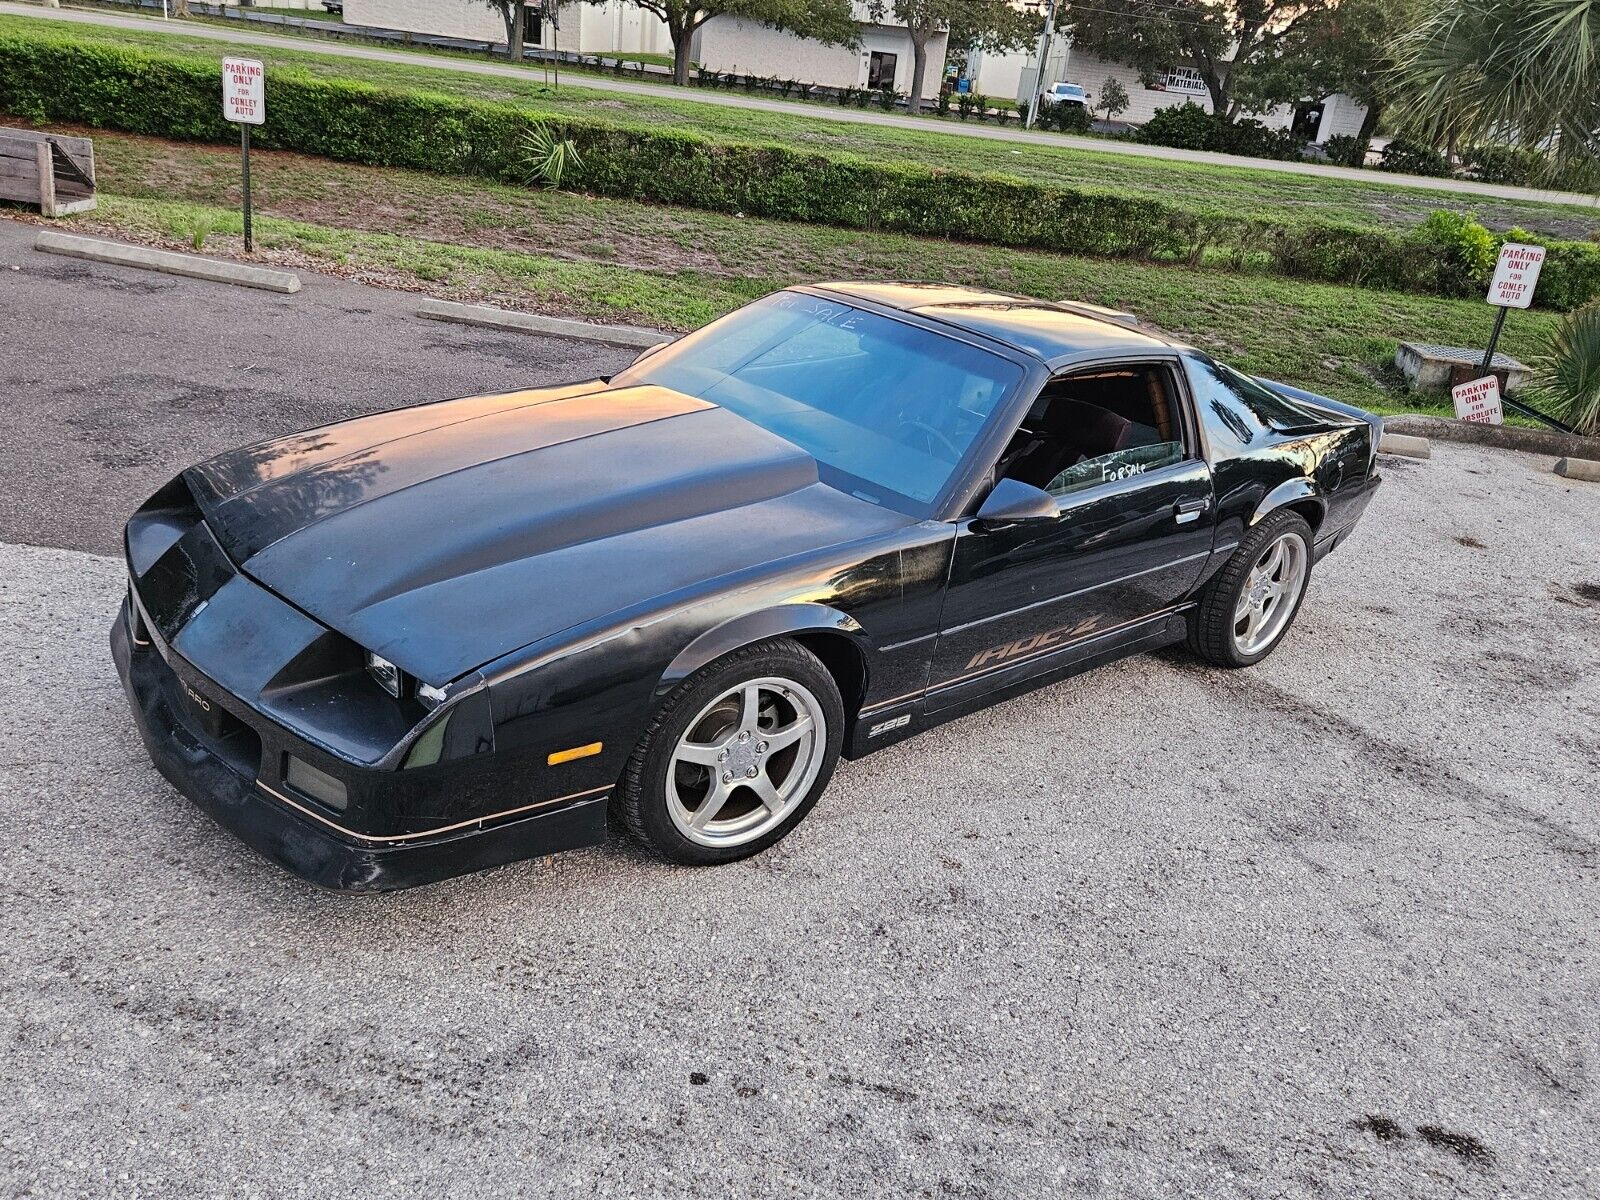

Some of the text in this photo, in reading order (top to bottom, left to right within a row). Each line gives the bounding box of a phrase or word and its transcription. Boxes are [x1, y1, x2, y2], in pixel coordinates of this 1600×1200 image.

[225, 63, 261, 76] PARKING
[233, 74, 253, 85] ONLY
[1167, 76, 1206, 91] MATERIALS
[238, 88, 249, 96] FOR
[230, 96, 257, 107] CONLEY
[235, 106, 253, 116] AUTO
[1502, 249, 1541, 262] PARKING
[1507, 260, 1530, 271] ONLY
[1510, 272, 1522, 281] FOR
[1498, 280, 1527, 292] CONLEY
[1500, 290, 1521, 300] AUTO
[800, 302, 863, 330] SALE
[1455, 380, 1495, 399] PARKING
[1465, 391, 1487, 404] ONLY
[1471, 403, 1484, 411] FOR
[964, 614, 1103, 670] IROC-Z
[868, 714, 911, 738] Z28
